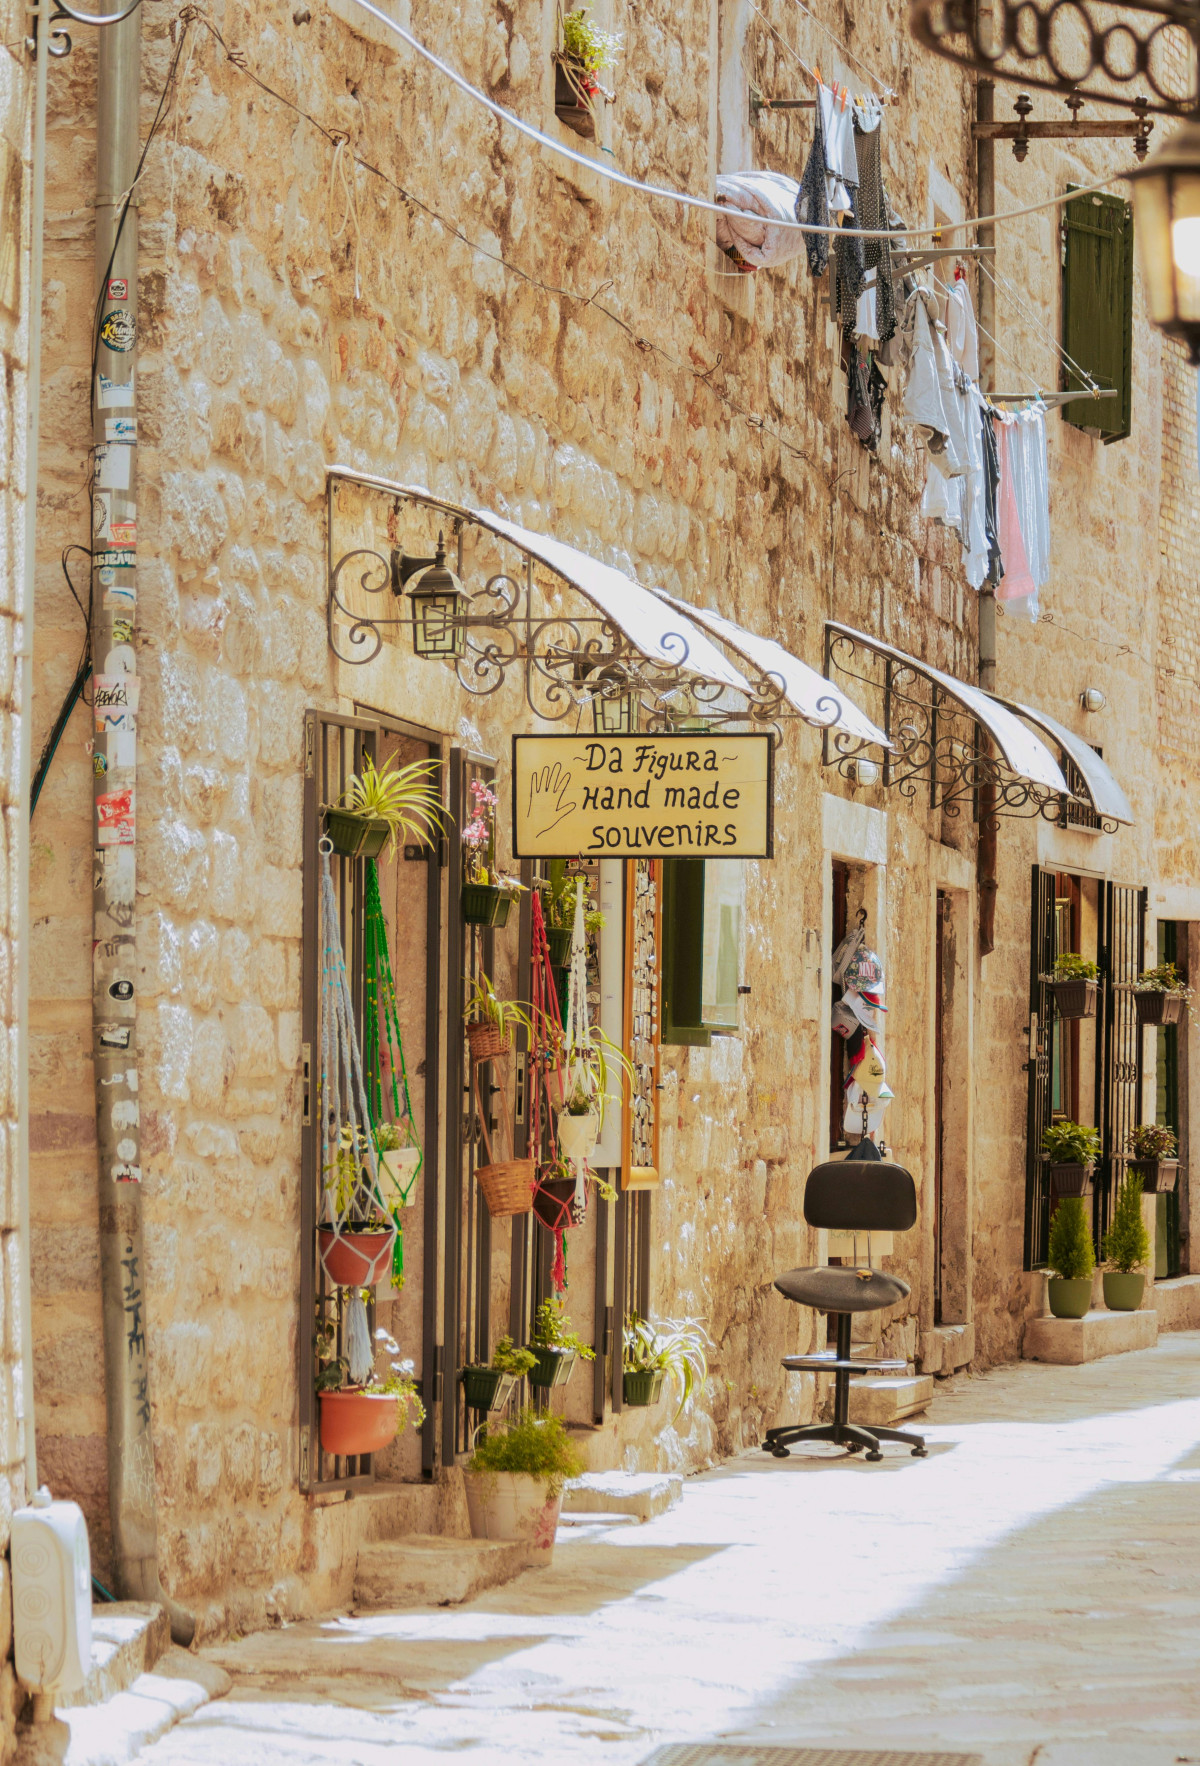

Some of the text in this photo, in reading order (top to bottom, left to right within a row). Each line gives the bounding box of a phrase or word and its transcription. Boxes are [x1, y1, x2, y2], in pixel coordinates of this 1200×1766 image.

[585, 743, 623, 773] Da
[582, 780, 740, 810] Hand made
[587, 820, 737, 849] souvenirs
